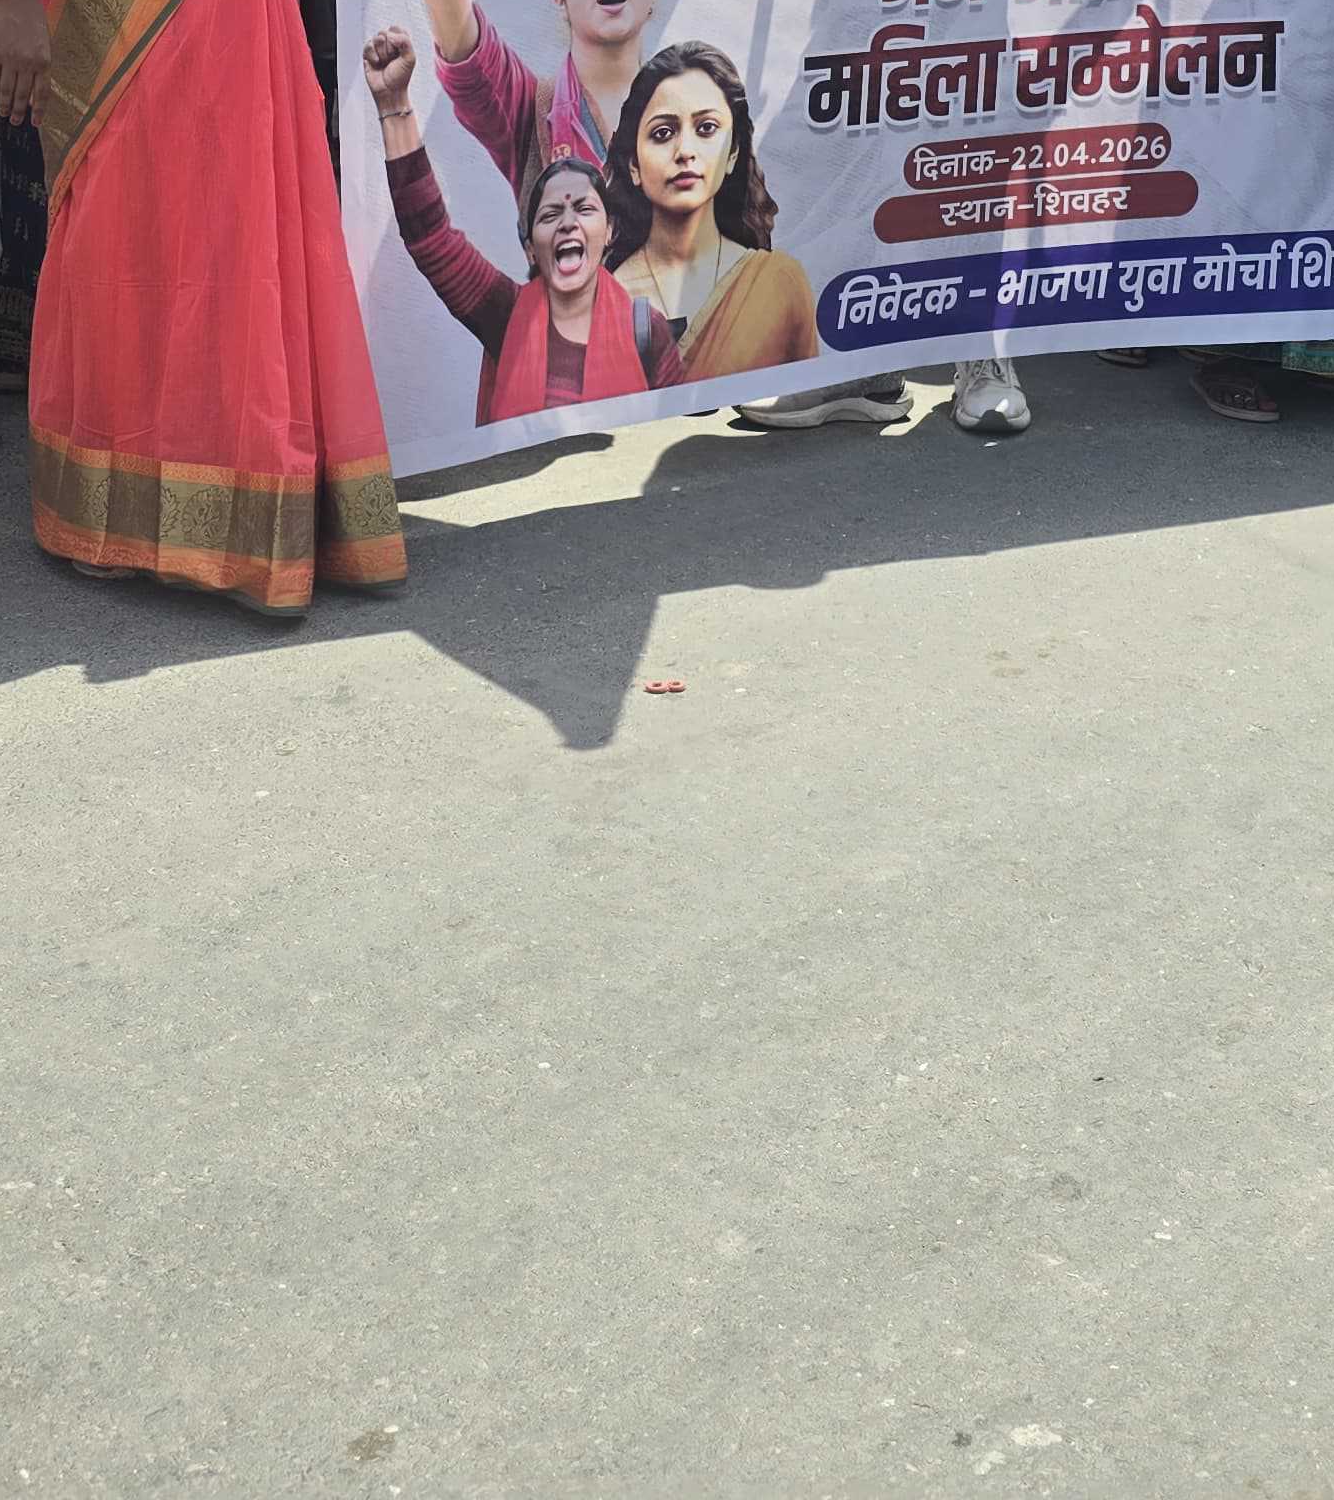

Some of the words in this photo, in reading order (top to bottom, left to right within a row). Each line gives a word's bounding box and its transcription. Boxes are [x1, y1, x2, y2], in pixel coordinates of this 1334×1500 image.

[803, 22, 1009, 129] महिला
[1011, 3, 1286, 108] सम्मेलन
[837, 272, 965, 330] निवेदक
[996, 261, 1114, 307] भाजपा
[1117, 256, 1188, 313] युवा
[1192, 239, 1287, 292] मोर्चा
